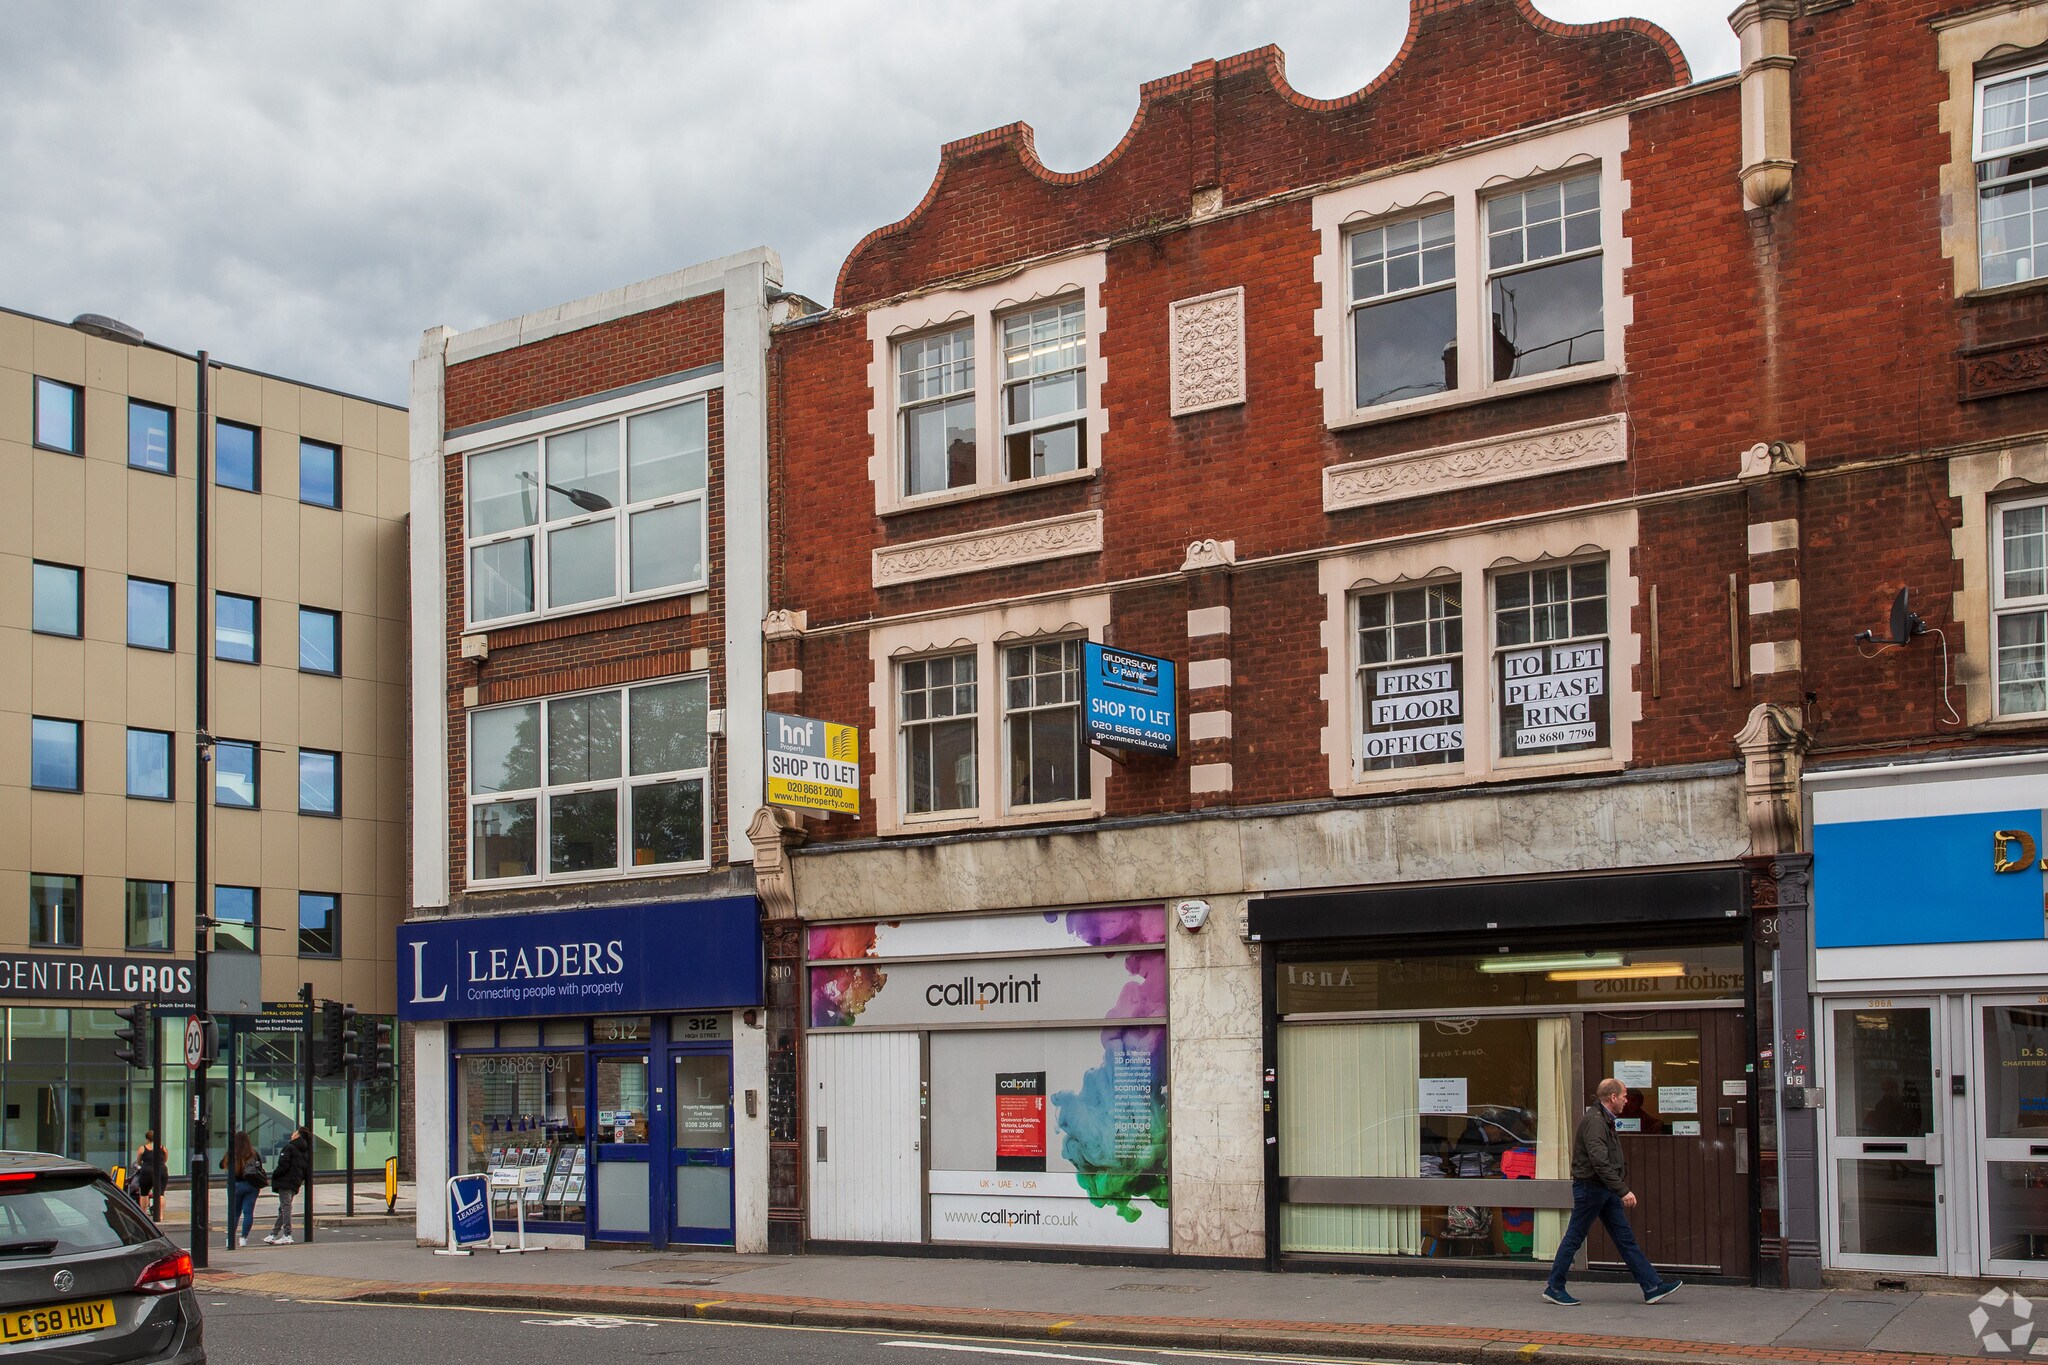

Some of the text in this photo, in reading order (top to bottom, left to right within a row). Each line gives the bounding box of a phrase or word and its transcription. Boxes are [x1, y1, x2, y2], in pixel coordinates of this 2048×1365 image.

[1102, 652, 1157, 672] GILDERSLEVE
[1508, 648, 1601, 677] TO LET
[1112, 666, 1148, 681] & PAYNE
[1383, 670, 1449, 694] FIRST
[1508, 676, 1600, 704] PLEASE
[1092, 698, 1171, 726] SHOP TO LET
[1378, 698, 1455, 723] FLOOR
[1526, 703, 1588, 727] RING
[779, 717, 814, 747] hnf
[1091, 720, 1171, 742] 020 8686 4400
[1096, 732, 1168, 750] gpcommercial.co.uk
[1517, 728, 1595, 745] 020 8680 7796
[780, 743, 805, 754] Property
[1367, 730, 1463, 758] OFFICES
[772, 755, 856, 785] SHOP TO LET
[787, 781, 843, 799] 020 8681 2000
[774, 791, 855, 810] www.hnfproperty.com
[1762, 918, 1795, 934] 308
[468, 940, 624, 982] LEADERS
[0, 960, 191, 994] CENTRALCROS
[409, 941, 448, 1003] L
[771, 966, 791, 979] 310
[467, 980, 624, 1002] Connecting people with property
[1868, 1000, 1893, 1008] 306A
[608, 1021, 638, 1041] 312
[688, 1018, 718, 1031] 312
[187, 1031, 200, 1053] 20
[1125, 1056, 1151, 1066] printing
[2022, 1048, 2048, 1057] D. S.
[470, 1056, 571, 1076] 020 8686 7941
[696, 1076, 712, 1099] L
[1114, 1084, 1151, 1094] scanning
[1114, 1121, 1151, 1132] signage
[979, 1179, 1037, 1189] UK UAE USA
[451, 1181, 482, 1215] L
[457, 1202, 485, 1221] LEADERS
[3, 1310, 62, 1338] LC68
[67, 1304, 105, 1328] HUY
